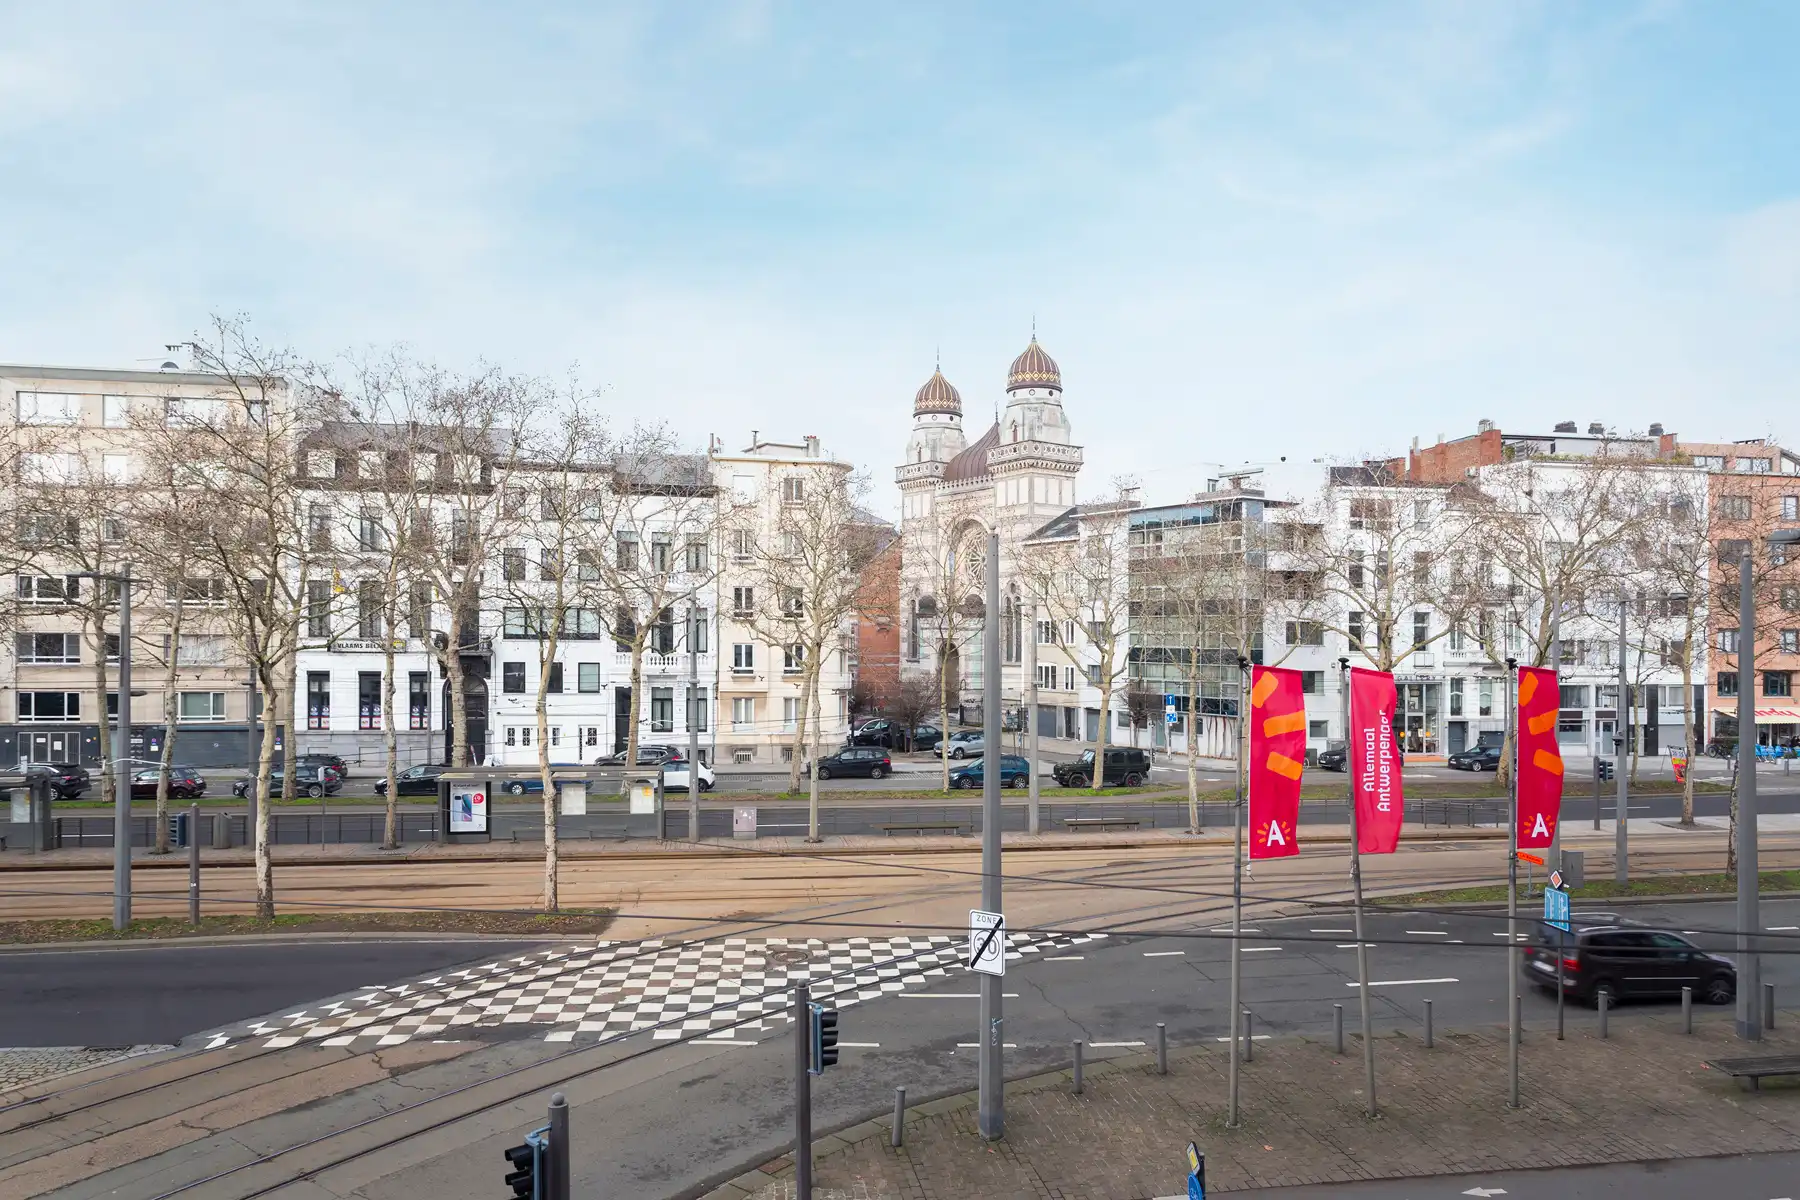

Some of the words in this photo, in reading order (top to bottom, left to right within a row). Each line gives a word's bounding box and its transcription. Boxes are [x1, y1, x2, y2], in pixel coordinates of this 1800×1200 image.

[1363, 727, 1375, 792] Allemaal
[1376, 710, 1393, 811] Antwerpenaar
[1266, 819, 1286, 847] A
[1531, 812, 1549, 838] A
[976, 914, 998, 925] ZONE
[976, 937, 997, 955] 30
